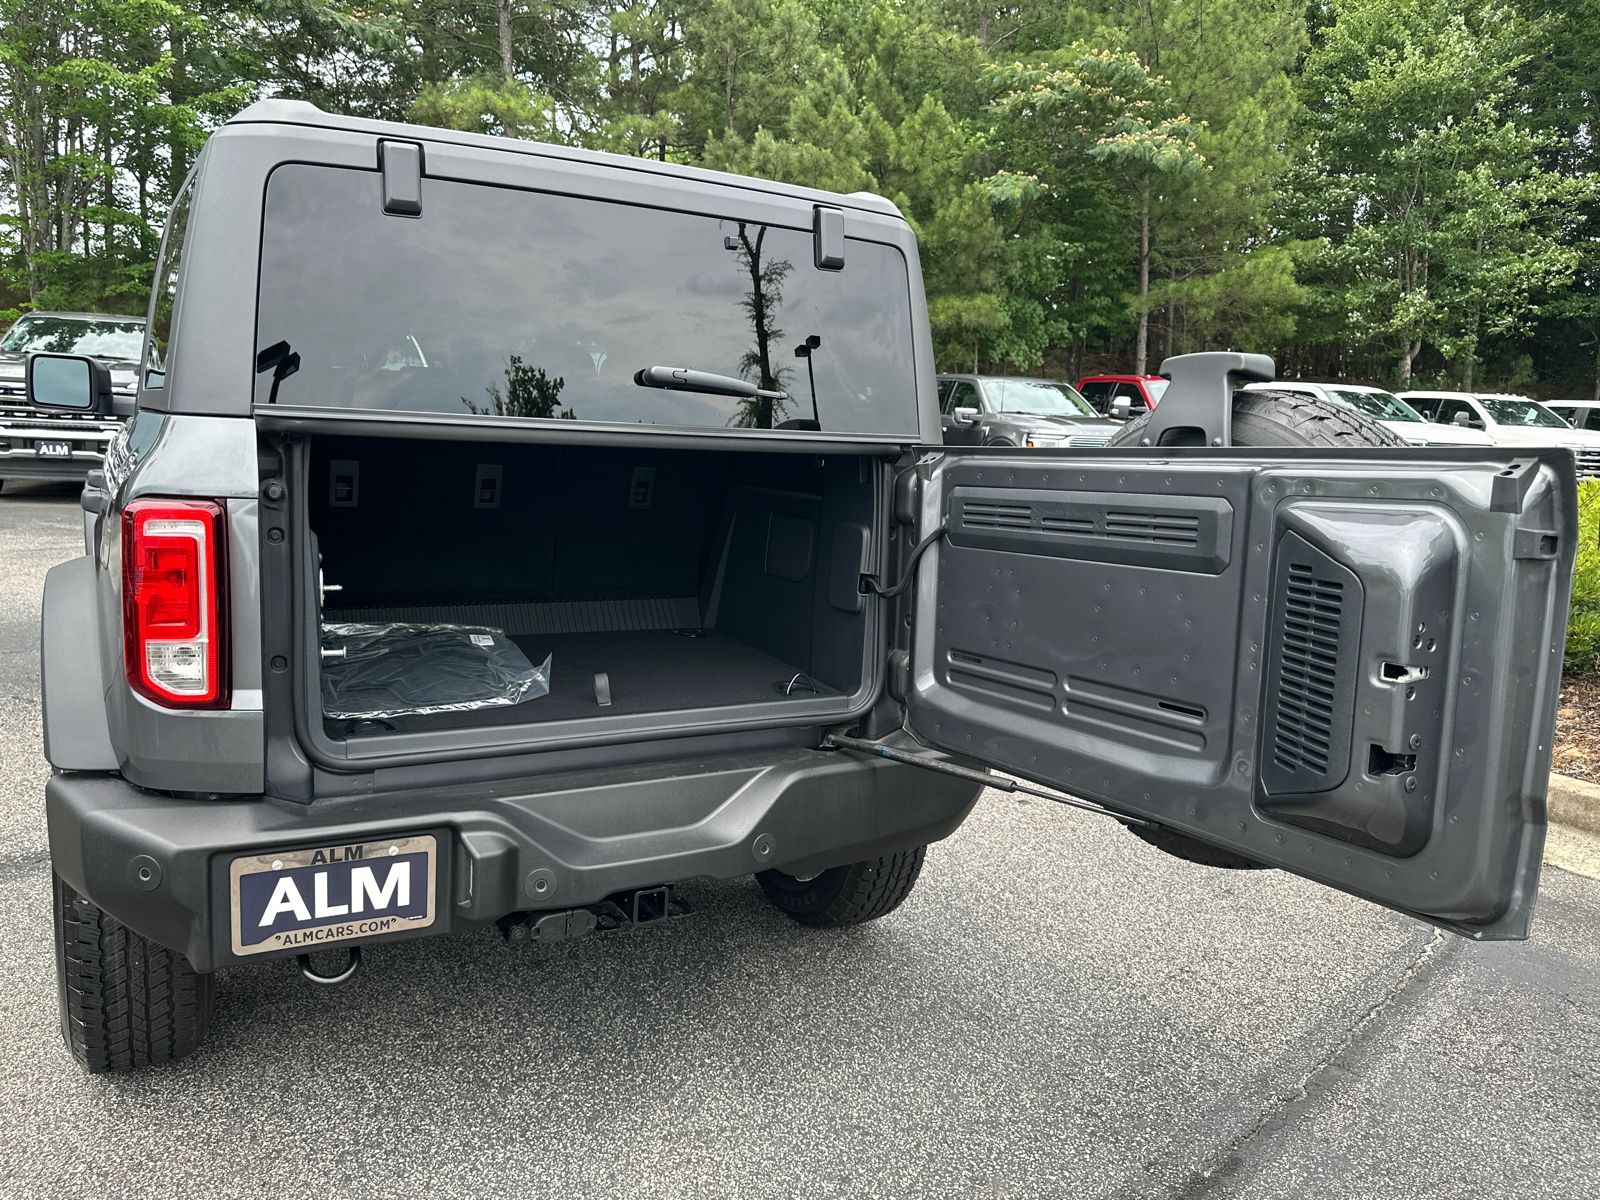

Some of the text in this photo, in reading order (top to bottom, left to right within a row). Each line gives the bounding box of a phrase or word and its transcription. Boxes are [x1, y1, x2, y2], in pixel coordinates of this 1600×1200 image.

[39, 444, 69, 456] ALM
[310, 845, 364, 865] ALM
[258, 861, 411, 927] ALM
[282, 919, 391, 946] ALMCARS.COM
